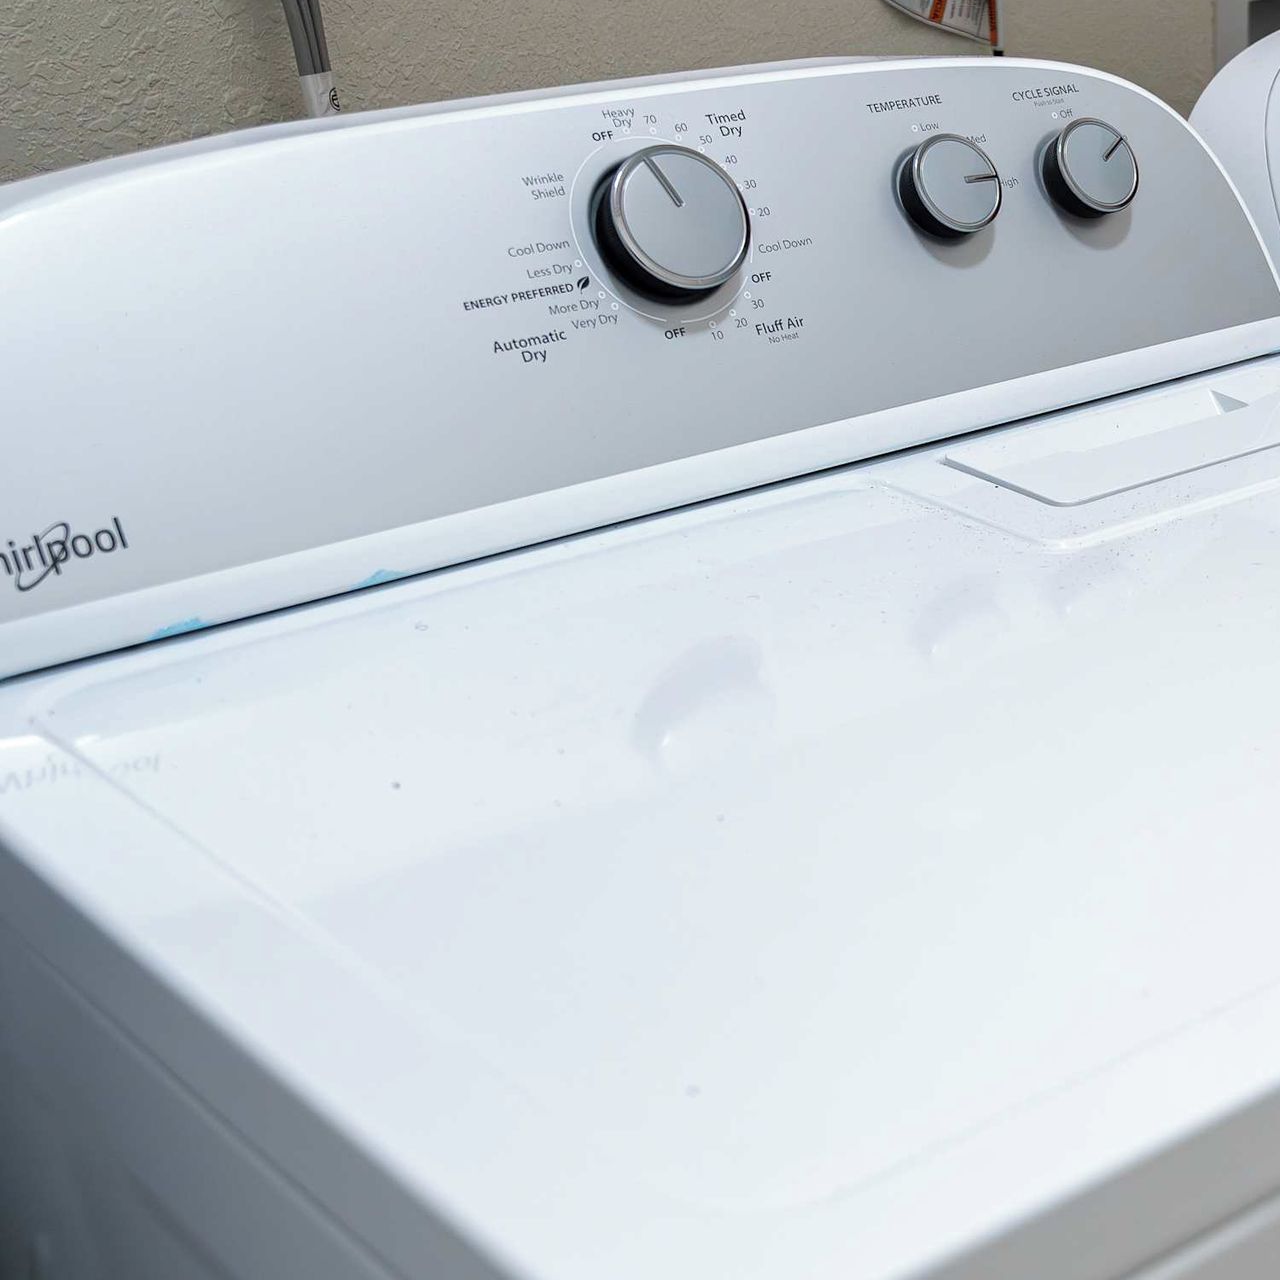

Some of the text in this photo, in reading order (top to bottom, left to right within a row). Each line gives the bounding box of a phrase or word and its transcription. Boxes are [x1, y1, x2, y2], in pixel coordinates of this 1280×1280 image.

[1012, 84, 1080, 102] CYCLE SIGNAL
[866, 94, 943, 114] TEMPERATURE
[602, 108, 635, 120] Heavy
[643, 114, 657, 124] 70
[705, 109, 746, 125] Timed
[1060, 108, 1073, 118] Off
[613, 118, 632, 128] Dry
[674, 122, 688, 132] 60
[920, 122, 940, 132] Low
[592, 130, 614, 142] OFF
[720, 126, 742, 137] Dry
[700, 134, 713, 145] 50
[966, 134, 987, 144] Med
[725, 154, 738, 165] 40
[521, 172, 564, 187] Wrinkle
[744, 179, 757, 190] 30
[531, 186, 566, 200] Shield
[758, 206, 771, 217] 20
[508, 239, 570, 258] Cool Down
[758, 236, 813, 254] Cool Down
[526, 263, 573, 279] Less Dry
[752, 272, 772, 284] OFF
[463, 283, 574, 311] ENERGY PREFERRED
[548, 298, 600, 316] More Dry
[752, 298, 765, 310] 30
[572, 313, 618, 330] Very Dry
[734, 317, 748, 328] 20
[755, 317, 804, 336] Fluff Air
[664, 327, 687, 340] OFF
[711, 330, 724, 340] 10
[768, 332, 800, 344] No Heat
[493, 330, 568, 354] Automatic
[521, 349, 548, 364] Dry
